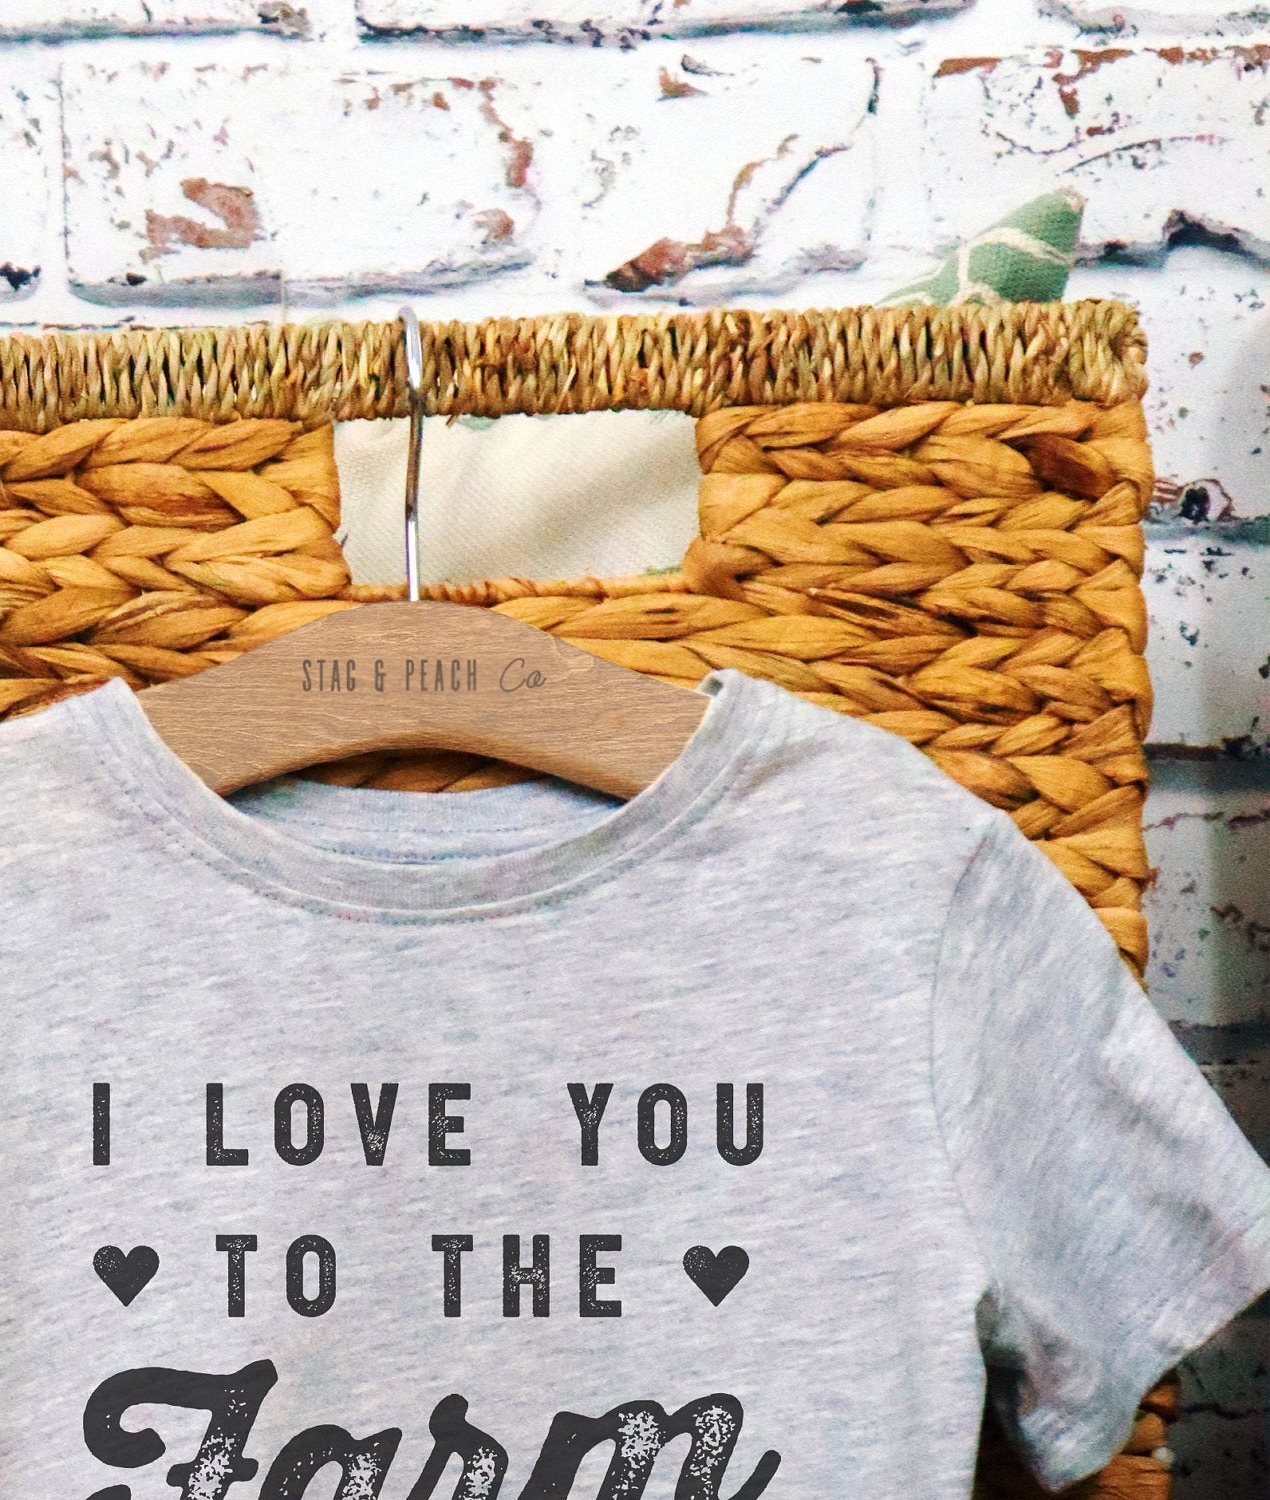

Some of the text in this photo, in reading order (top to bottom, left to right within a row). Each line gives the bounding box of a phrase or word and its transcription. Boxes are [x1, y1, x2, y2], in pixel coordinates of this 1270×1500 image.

[301, 657, 547, 693] STAG & PEACH Co
[92, 1082, 764, 1167] I LOVE YOU
[215, 1234, 622, 1318] TO THE
